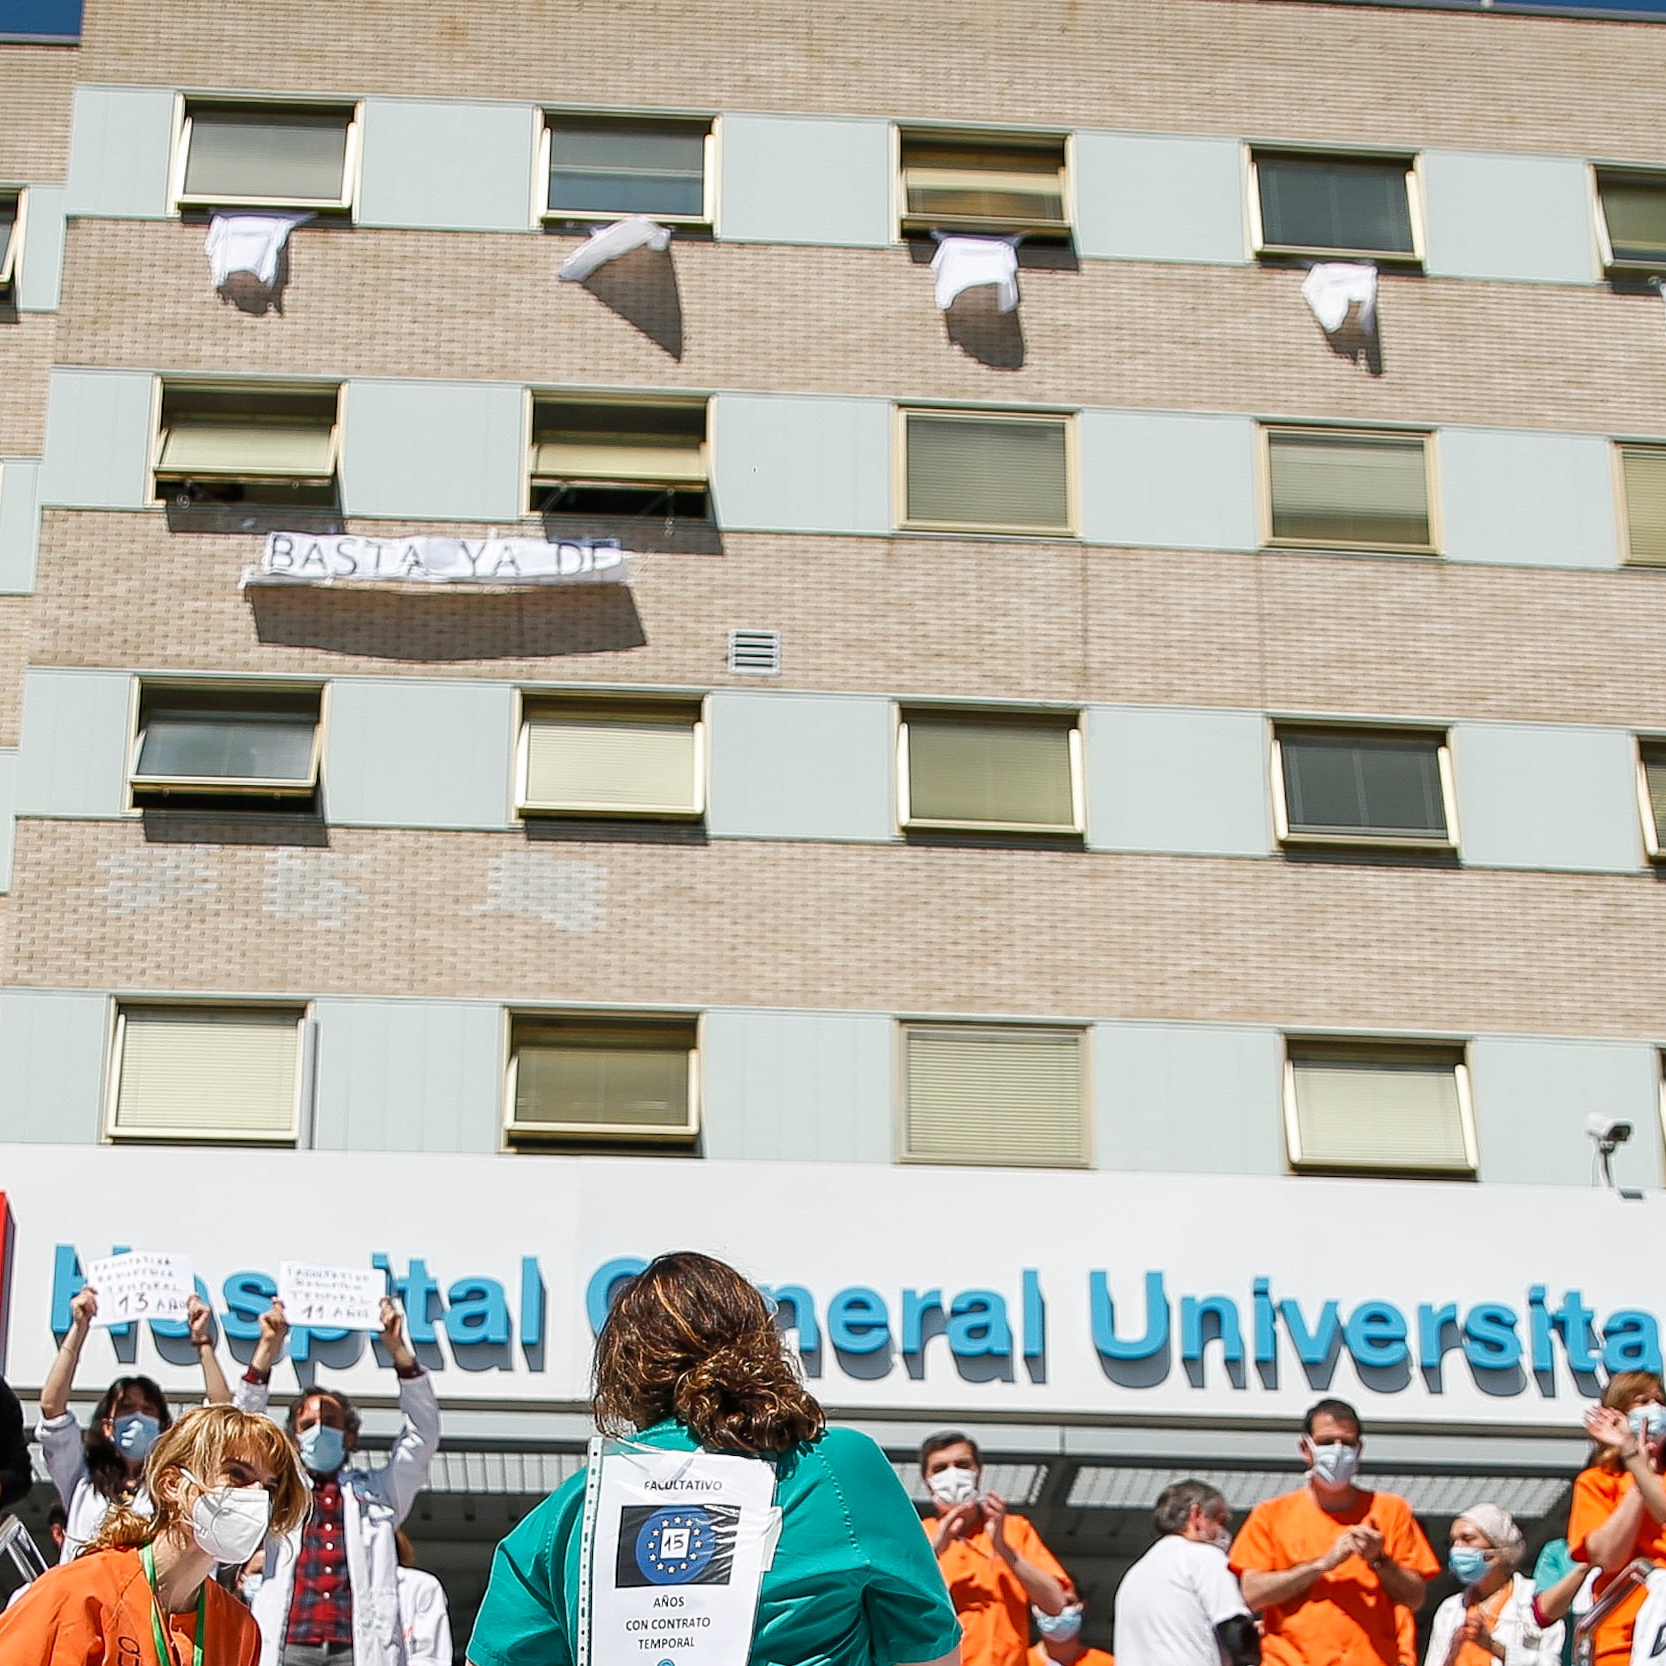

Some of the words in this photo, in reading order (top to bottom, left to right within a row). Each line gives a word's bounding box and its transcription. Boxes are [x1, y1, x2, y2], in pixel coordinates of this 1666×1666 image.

[269, 533, 430, 576] BASTA
[458, 543, 522, 576] YA
[117, 1291, 150, 1317] 13
[643, 1479, 723, 1492] FACULTATIVO
[663, 1539, 685, 1552] 15
[652, 1594, 686, 1609] AÑOS
[625, 1620, 650, 1632] CON
[651, 1616, 711, 1631] CONTRATO
[637, 1636, 696, 1651] TEMPORAL
